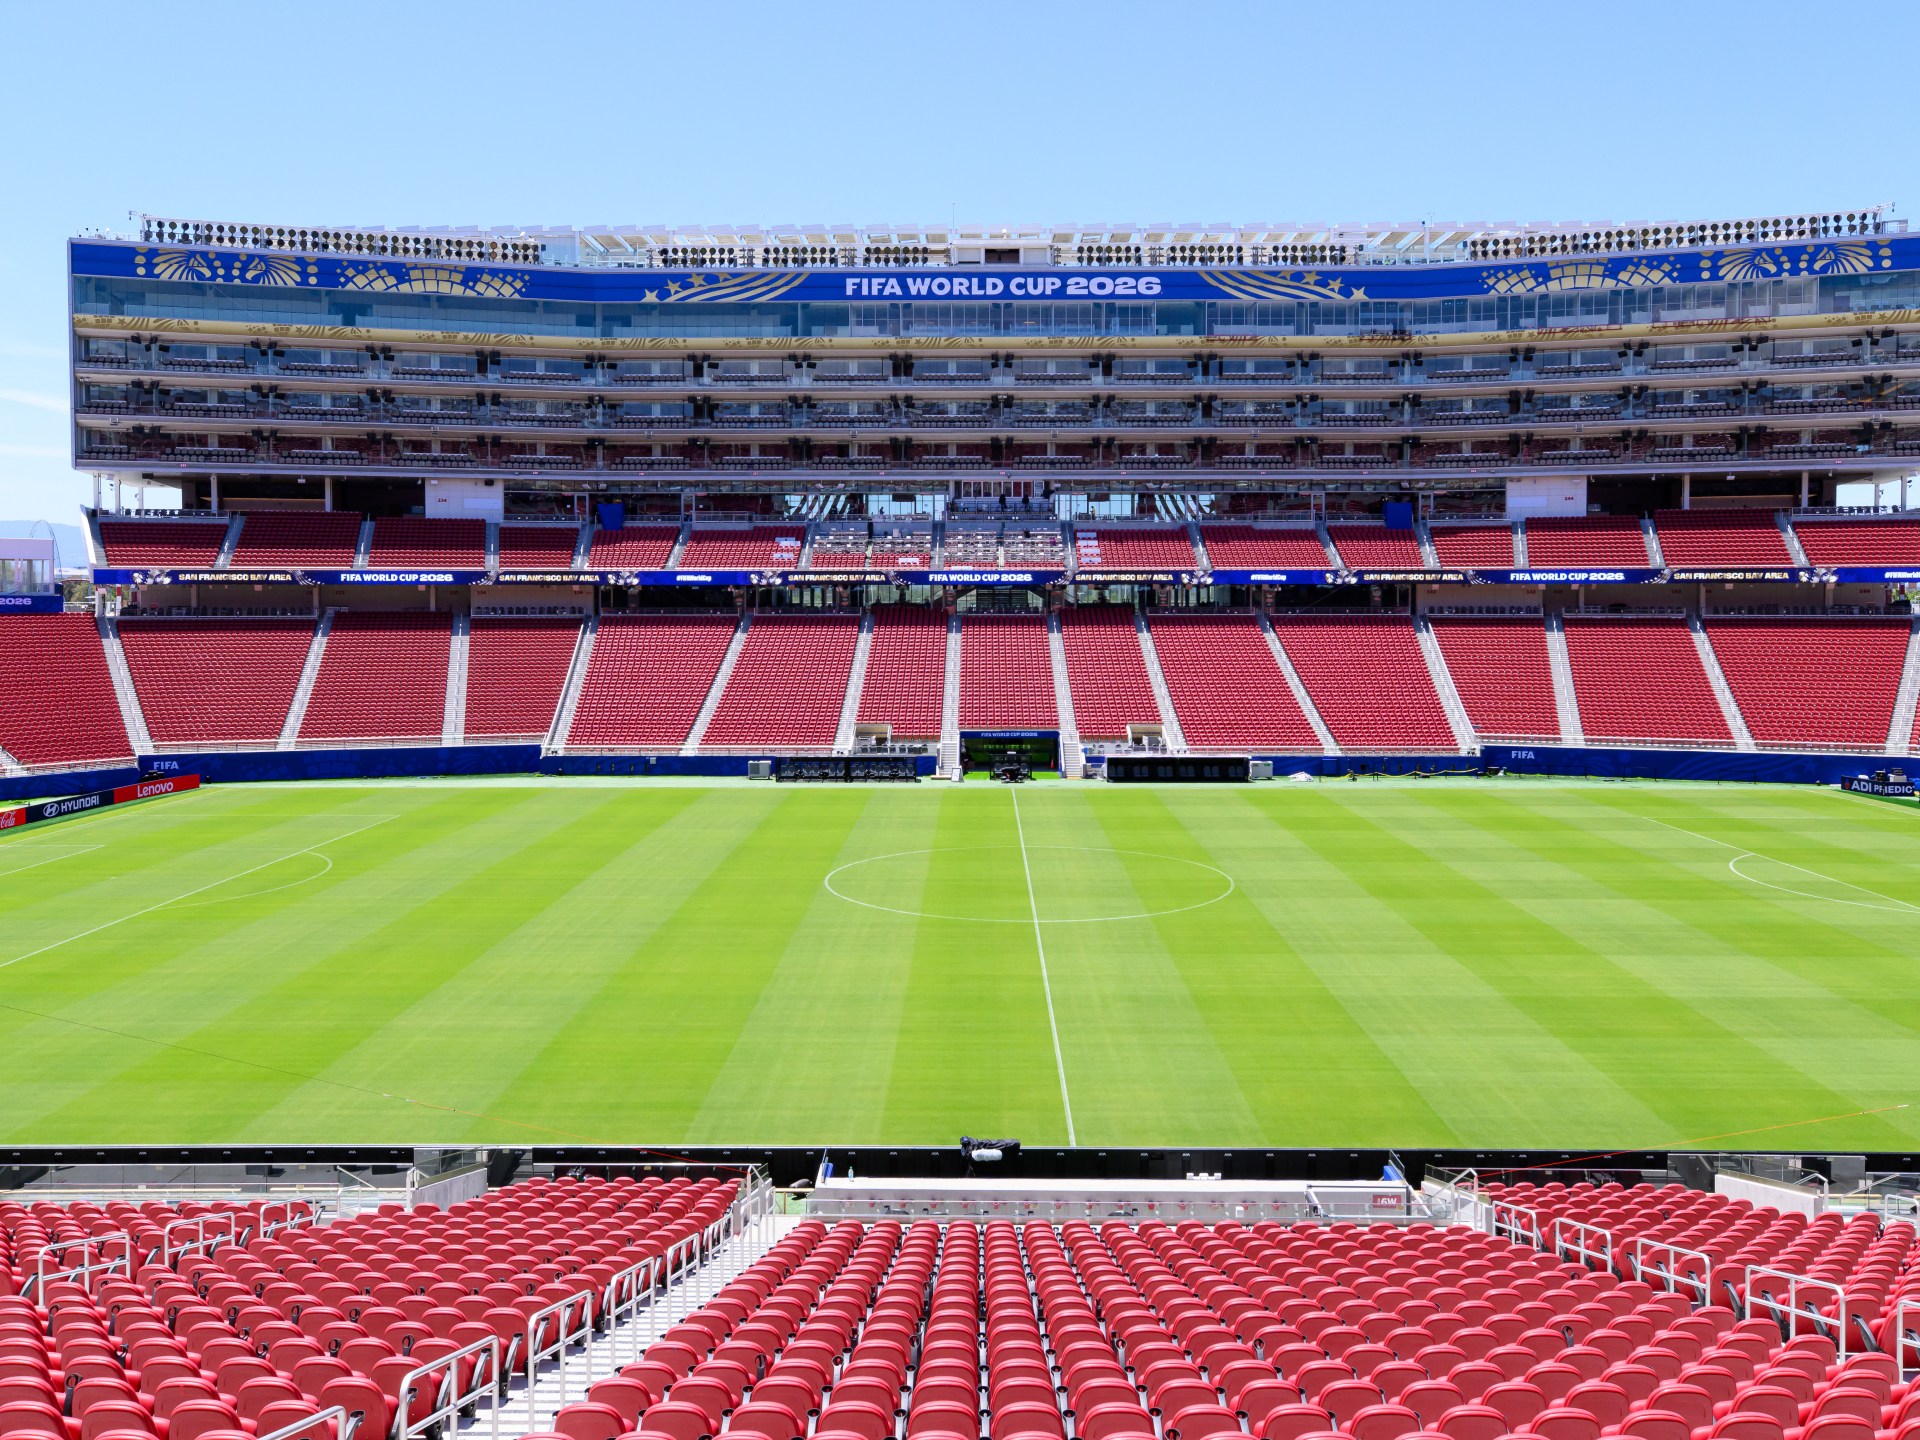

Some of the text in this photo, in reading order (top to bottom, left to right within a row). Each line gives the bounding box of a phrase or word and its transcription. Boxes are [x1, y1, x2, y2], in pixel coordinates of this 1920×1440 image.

[846, 277, 1162, 296] FIFA WORLD CUP 2026
[178, 573, 292, 581] SAN FRANCISCO BAY AREA
[340, 573, 454, 582] FIFA WORLD CUP 2026
[499, 574, 600, 582] SAN FRANCISCO BAY AREA
[788, 574, 886, 582] SAN FRANCISCO BAY AREA
[928, 573, 1033, 582] FIFA WORLD CUP 2026
[1363, 573, 1464, 581] SAN FRANCISCO BAY AREA
[1510, 572, 1625, 581] FIFA WORLD CUP 2026
[1673, 571, 1789, 580] SAN FRANCISCO BAY AREA
[0, 597, 32, 605] 2026
[1511, 750, 1535, 760] FIFA
[153, 761, 179, 770] FIFA
[137, 781, 174, 798] Lenovo
[1851, 780, 1872, 793] ADI
[61, 795, 99, 813] HYUNDAI
